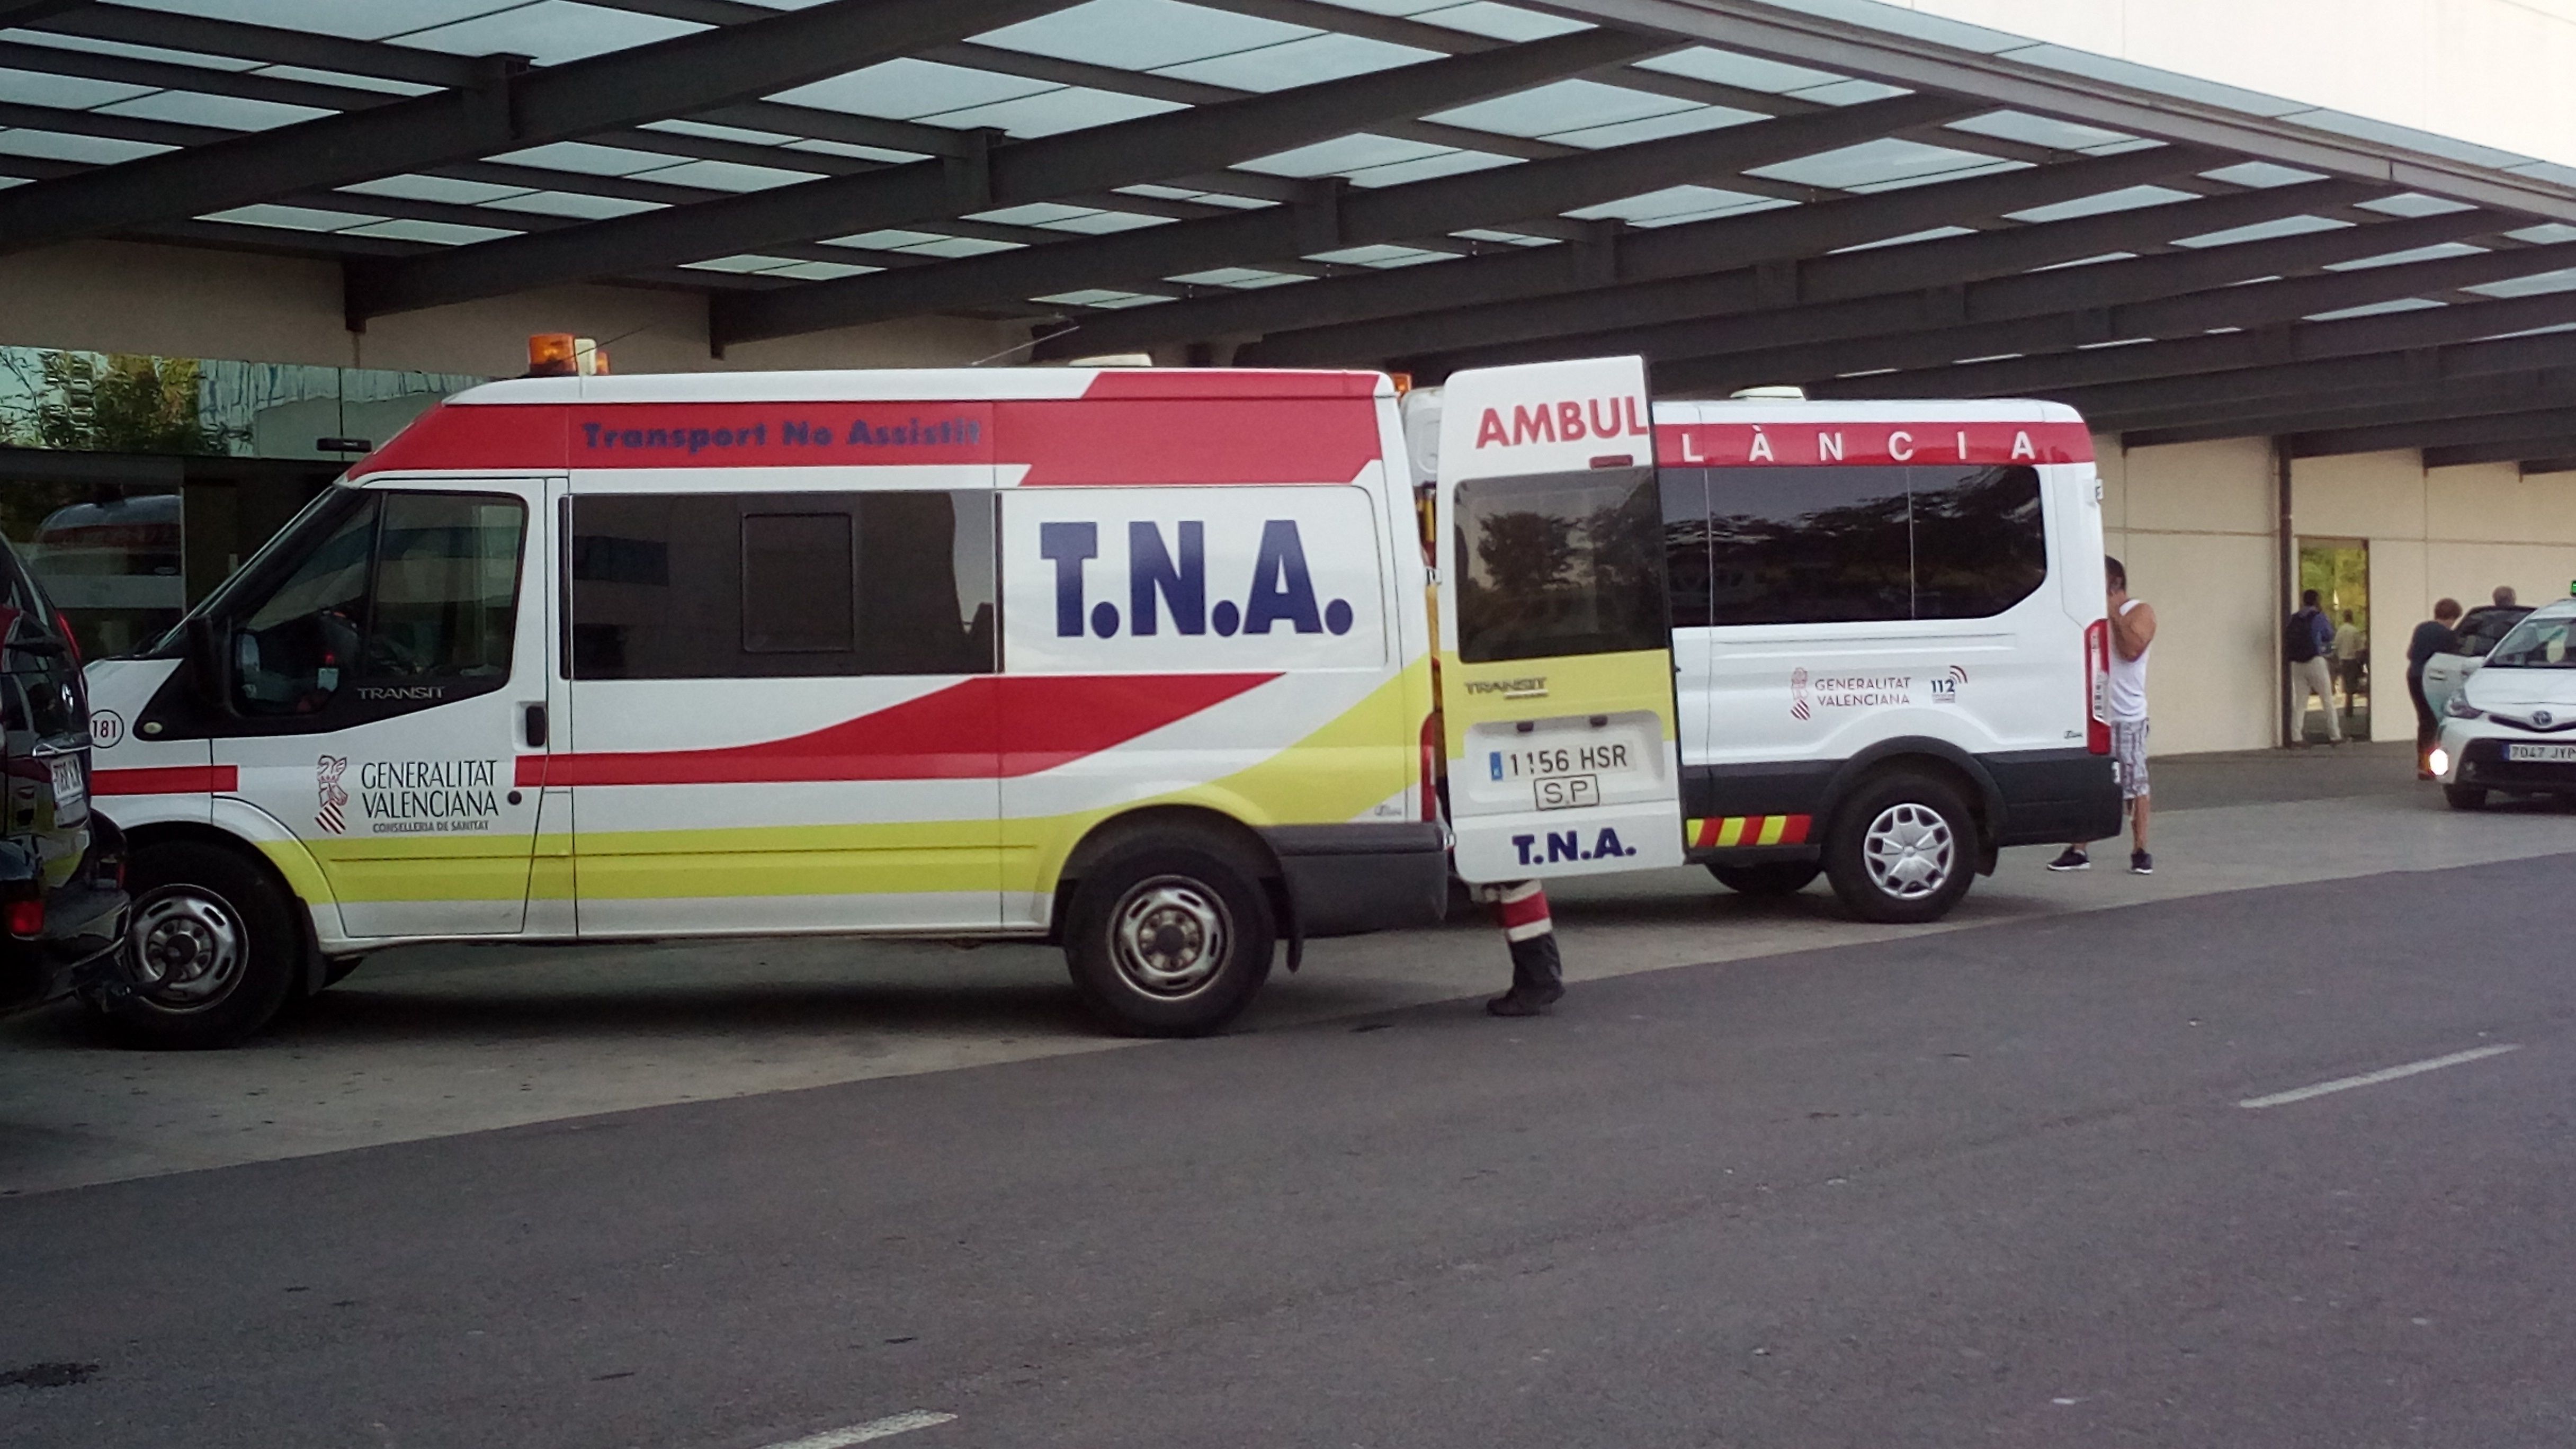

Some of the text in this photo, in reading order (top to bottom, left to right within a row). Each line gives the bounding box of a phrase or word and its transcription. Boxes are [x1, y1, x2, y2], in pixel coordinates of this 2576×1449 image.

[1475, 396, 1648, 449] AMBUL
[583, 422, 766, 453] Transport
[782, 421, 833, 446] No
[1040, 520, 1353, 639] T.N.A.
[357, 686, 445, 700] TRANSIT
[1464, 677, 1547, 695] TRANSIT
[1815, 677, 1911, 691] GENERALITAT
[1931, 678, 1955, 693] 112
[1818, 693, 1910, 706] VALENCIANA
[92, 720, 116, 739] 181
[361, 759, 498, 789] GENERALITAT
[1510, 745, 1627, 776] 1156 HSR
[362, 790, 499, 818] VALENCIANA
[1512, 827, 1637, 865] T.N.A.
